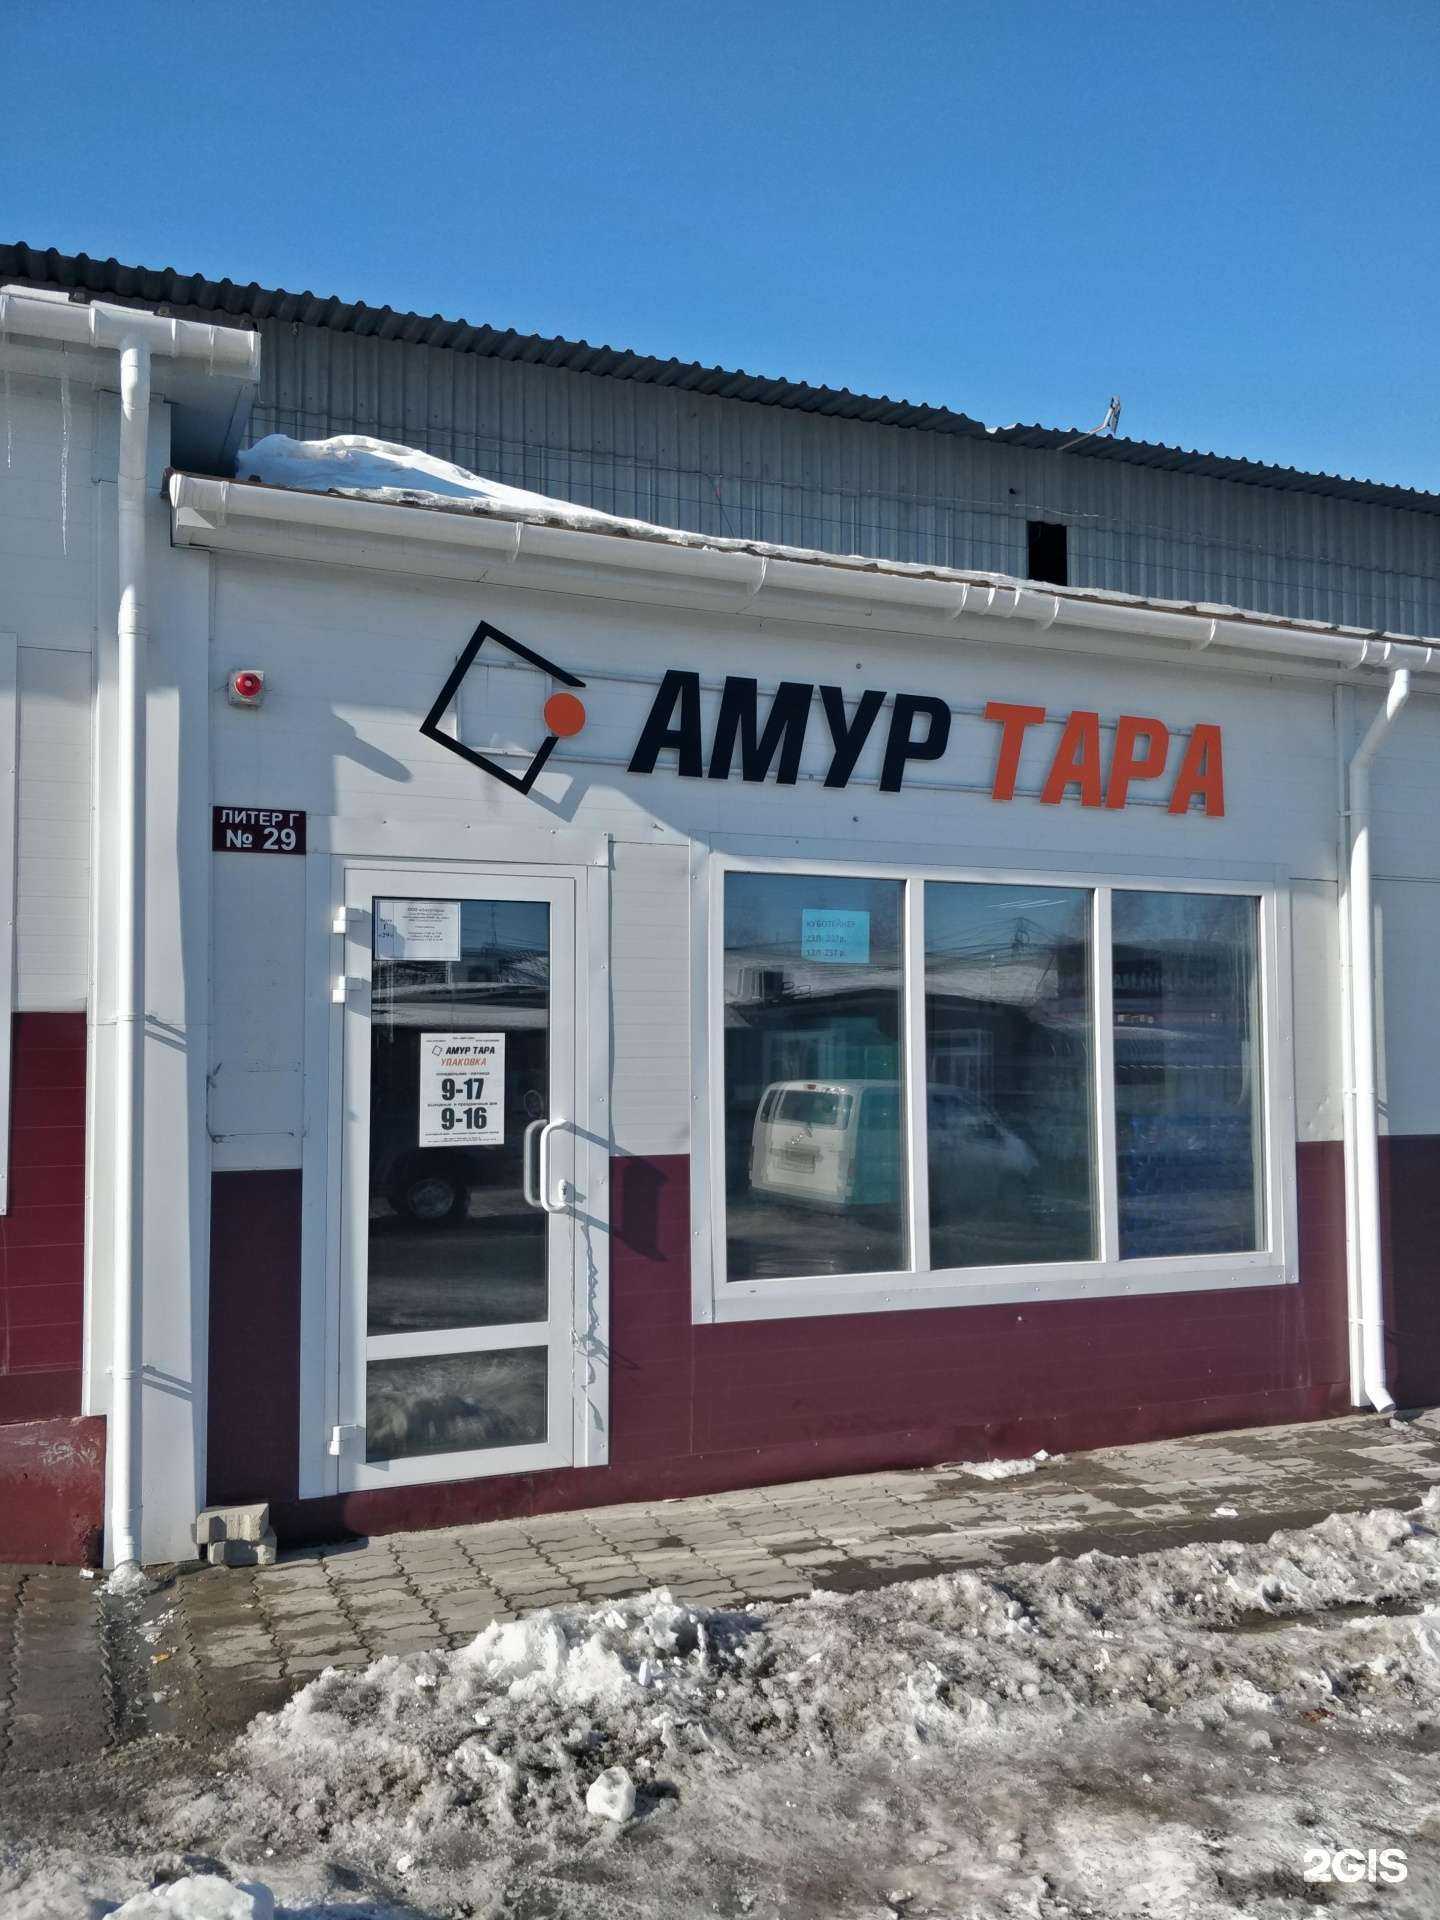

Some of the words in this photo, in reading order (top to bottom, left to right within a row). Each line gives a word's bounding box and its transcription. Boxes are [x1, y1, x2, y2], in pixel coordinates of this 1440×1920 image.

[627, 669, 952, 792] АМУР
[983, 701, 1226, 818] ТАРА
[220, 809, 283, 826] ЛИТЕР
[289, 813, 300, 827] Г
[226, 829, 253, 848] №
[263, 827, 297, 851] 29
[441, 1057, 487, 1066] УПАКОВКА
[445, 1046, 471, 1055] АМУР
[473, 1046, 496, 1055] ТАРА
[441, 1078, 485, 1101] 9-17
[441, 1107, 487, 1130] 9-16
